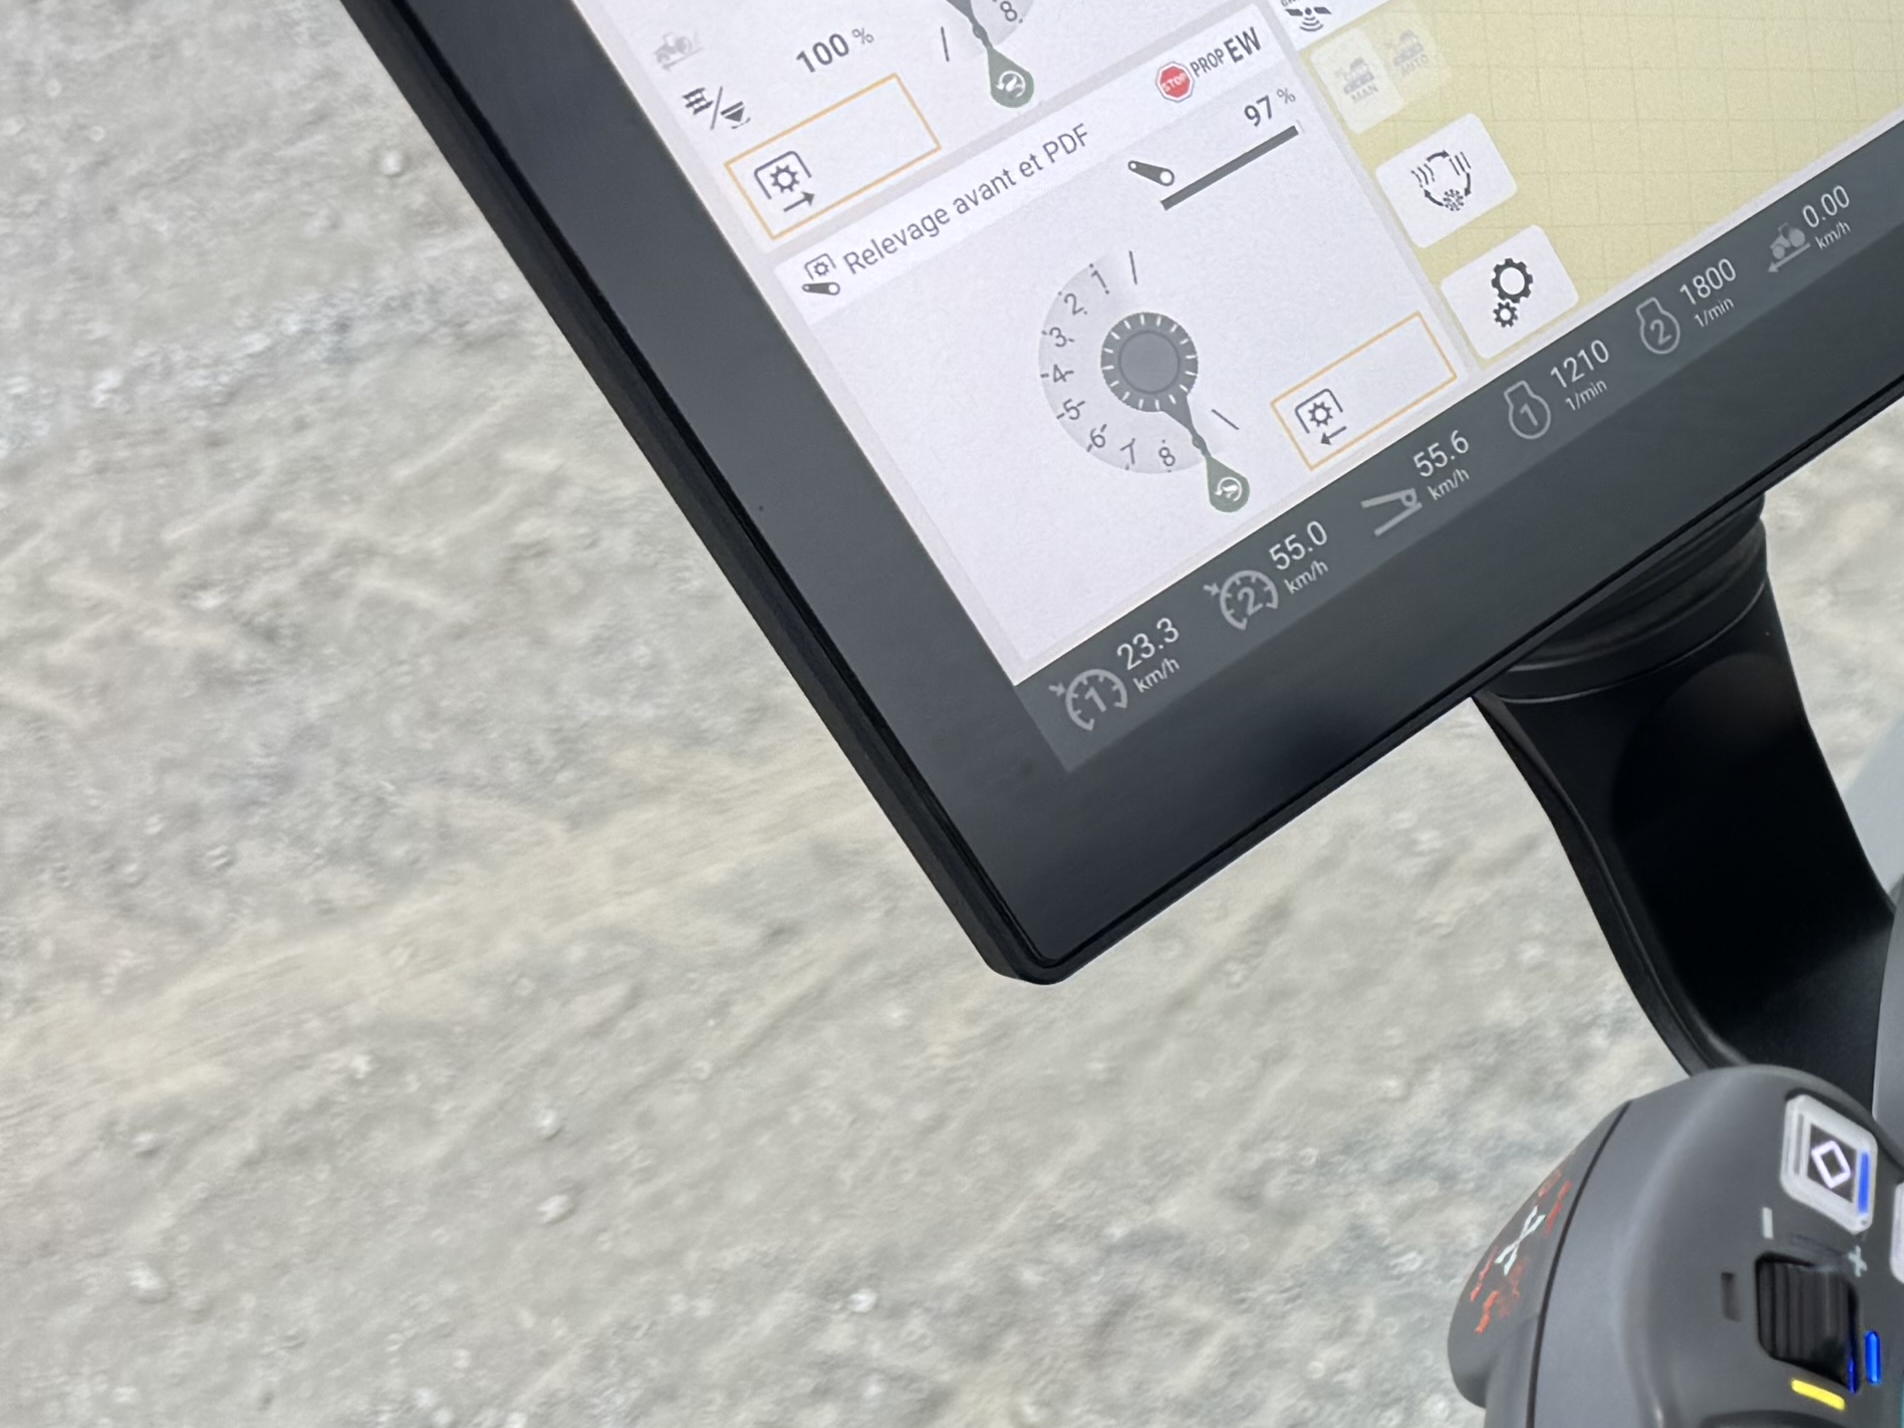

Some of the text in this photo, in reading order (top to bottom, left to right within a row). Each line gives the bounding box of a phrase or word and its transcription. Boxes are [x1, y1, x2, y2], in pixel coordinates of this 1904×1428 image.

[1000, 0, 1018, 22] 8
[796, 28, 875, 73] 100 %
[1161, 27, 1262, 94] STOP PROP EW
[1243, 88, 1296, 127] 97 %
[1350, 84, 1379, 103] MAN
[843, 123, 1090, 274] Relevage avant et PDF
[1802, 184, 1851, 230] 0.00
[1816, 219, 1852, 250] km/h
[1091, 270, 1108, 292] 1
[1680, 258, 1737, 306] 1800
[1063, 292, 1084, 316] 2
[1694, 295, 1736, 328] 1/min
[1049, 326, 1068, 348] 3
[1650, 318, 1672, 346] 2
[1051, 364, 1069, 385] 4
[1550, 339, 1610, 390] 1210
[1566, 377, 1608, 412] 1/min
[1064, 400, 1081, 421] 5
[1520, 402, 1540, 429] 1
[1088, 428, 1107, 449] 6
[1120, 438, 1137, 465] 7
[1413, 430, 1470, 477] 55.6
[1158, 447, 1176, 468] 8
[1426, 468, 1470, 500] km/h
[1268, 520, 1328, 572] 55.0
[1284, 559, 1329, 595] km/h
[1238, 586, 1264, 617] 2
[1116, 617, 1180, 671] 23.3
[1133, 656, 1180, 693] km/h
[1084, 686, 1107, 713] 1
